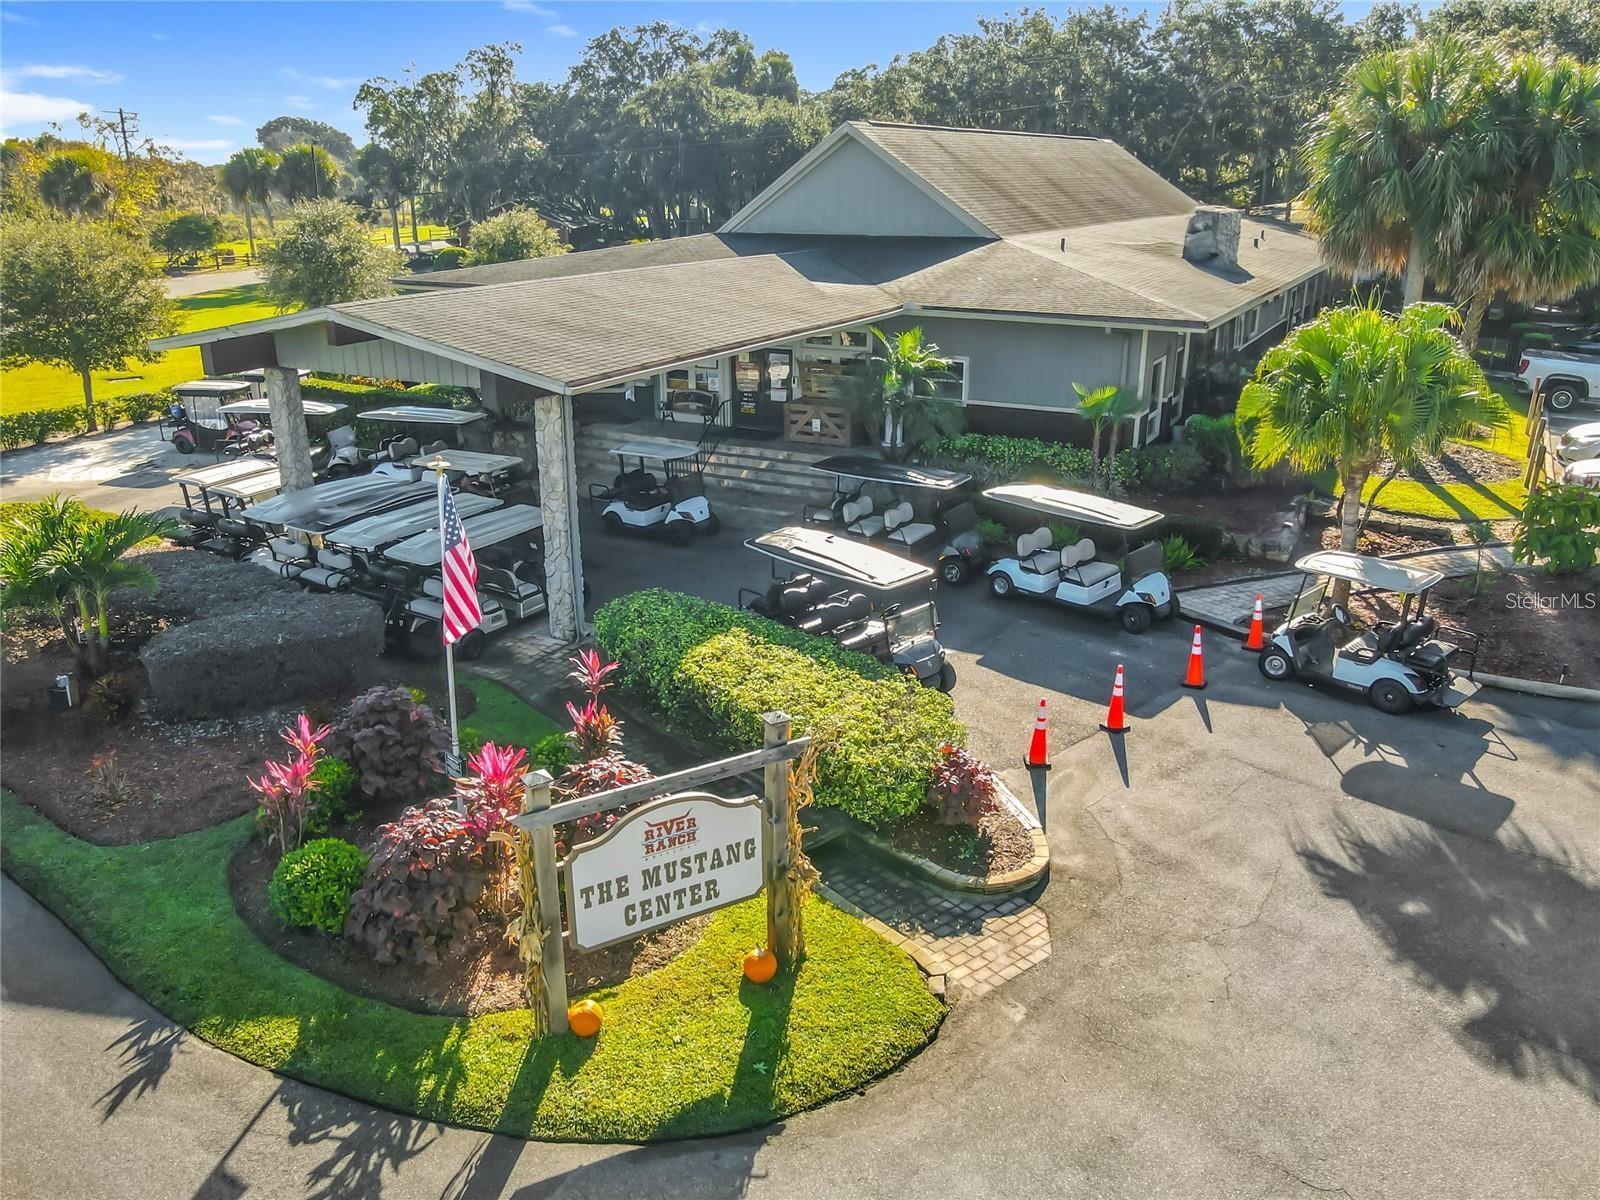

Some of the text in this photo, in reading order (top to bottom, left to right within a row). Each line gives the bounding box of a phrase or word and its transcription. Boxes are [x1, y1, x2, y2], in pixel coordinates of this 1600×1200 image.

[644, 814, 697, 841] RIVER
[645, 831, 697, 855] RANCH
[579, 875, 630, 909] THE
[641, 838, 757, 891] MUSTANG
[624, 878, 720, 927] CENTER
